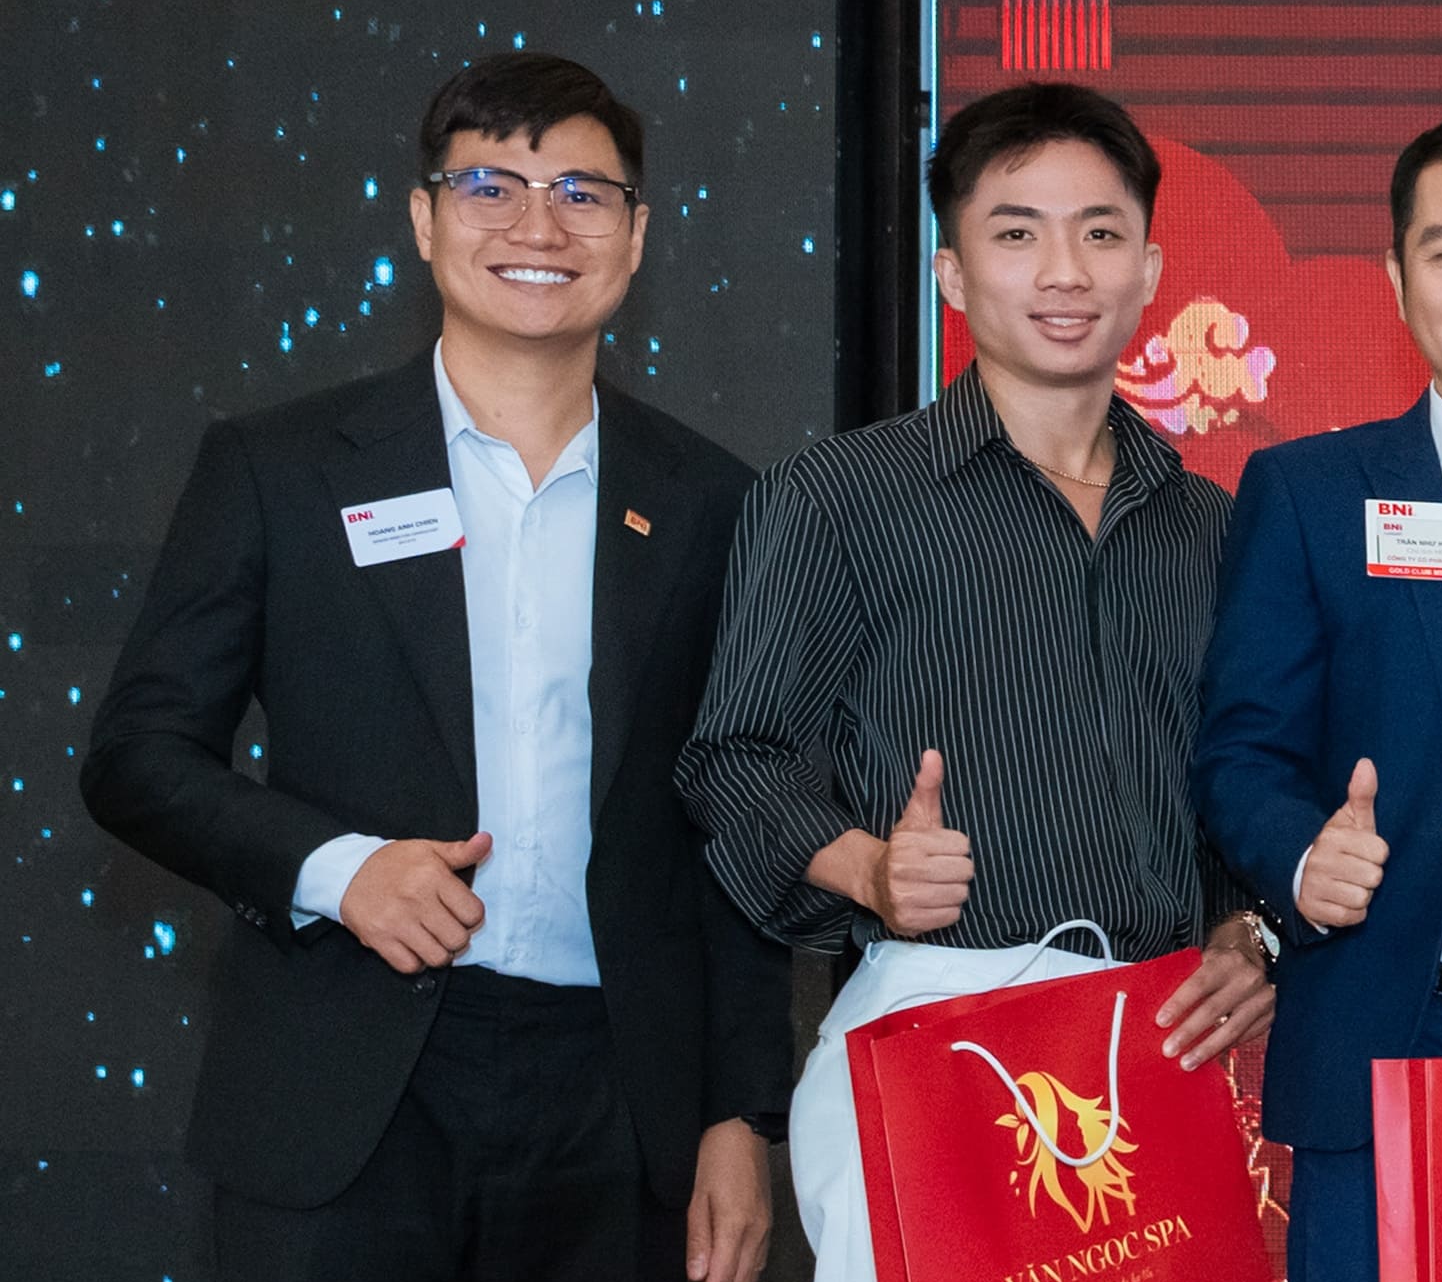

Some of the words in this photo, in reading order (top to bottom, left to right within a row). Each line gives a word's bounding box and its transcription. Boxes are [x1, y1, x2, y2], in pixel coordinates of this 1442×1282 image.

[347, 509, 373, 524] BNI
[1379, 503, 1413, 516] BNI
[1066, 1230, 1138, 1280] NGỌC
[1143, 1214, 1192, 1251] SPA
